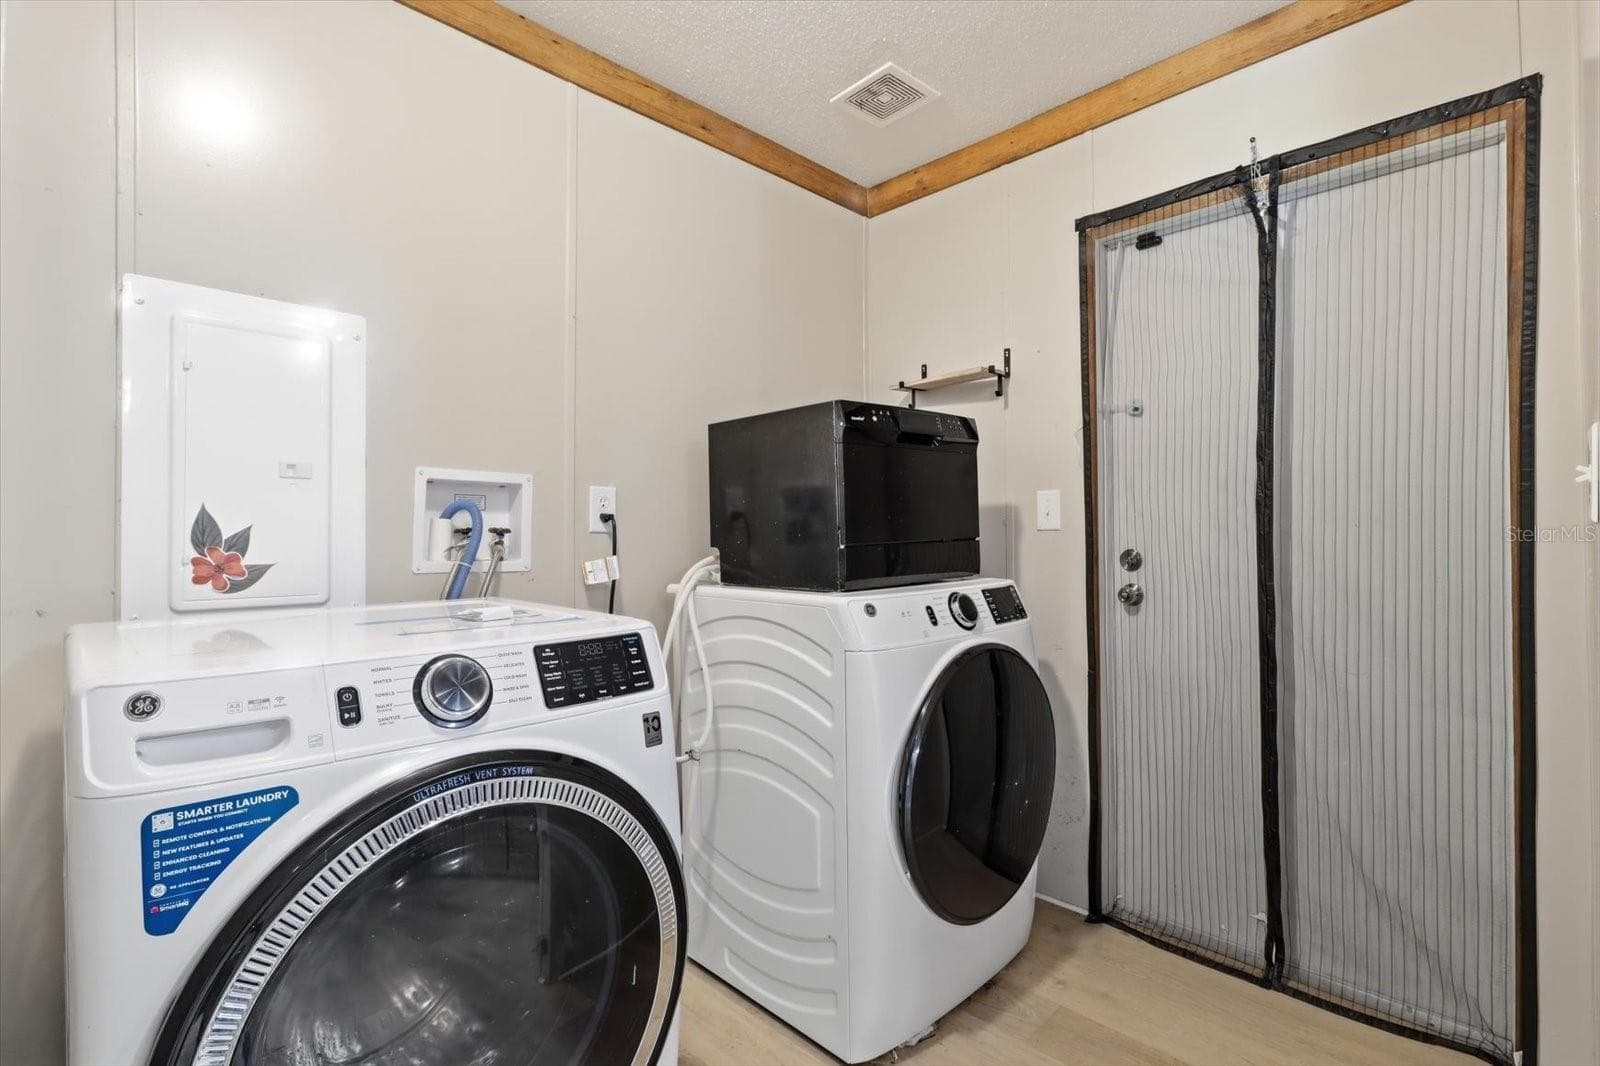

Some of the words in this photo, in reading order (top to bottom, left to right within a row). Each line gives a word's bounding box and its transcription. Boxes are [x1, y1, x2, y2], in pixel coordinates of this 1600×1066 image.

[413, 774, 471, 802] ULTRAFRESH
[475, 768, 497, 781] VENT
[502, 766, 534, 776] SYSTEM
[176, 801, 233, 821] SMARTER
[236, 789, 289, 809] LAUNDRY
[161, 834, 188, 845] REMOTE
[188, 827, 219, 839] CONTROL
[225, 816, 271, 831] NOTIFICATIONS
[162, 848, 178, 856] NEW
[178, 840, 209, 852] FEATURES
[216, 833, 244, 844] UPDATES
[162, 854, 198, 867] ENHANCED
[198, 846, 230, 859] CLEANING
[162, 867, 188, 878] ENERGY
[189, 859, 222, 872] TRACKING
